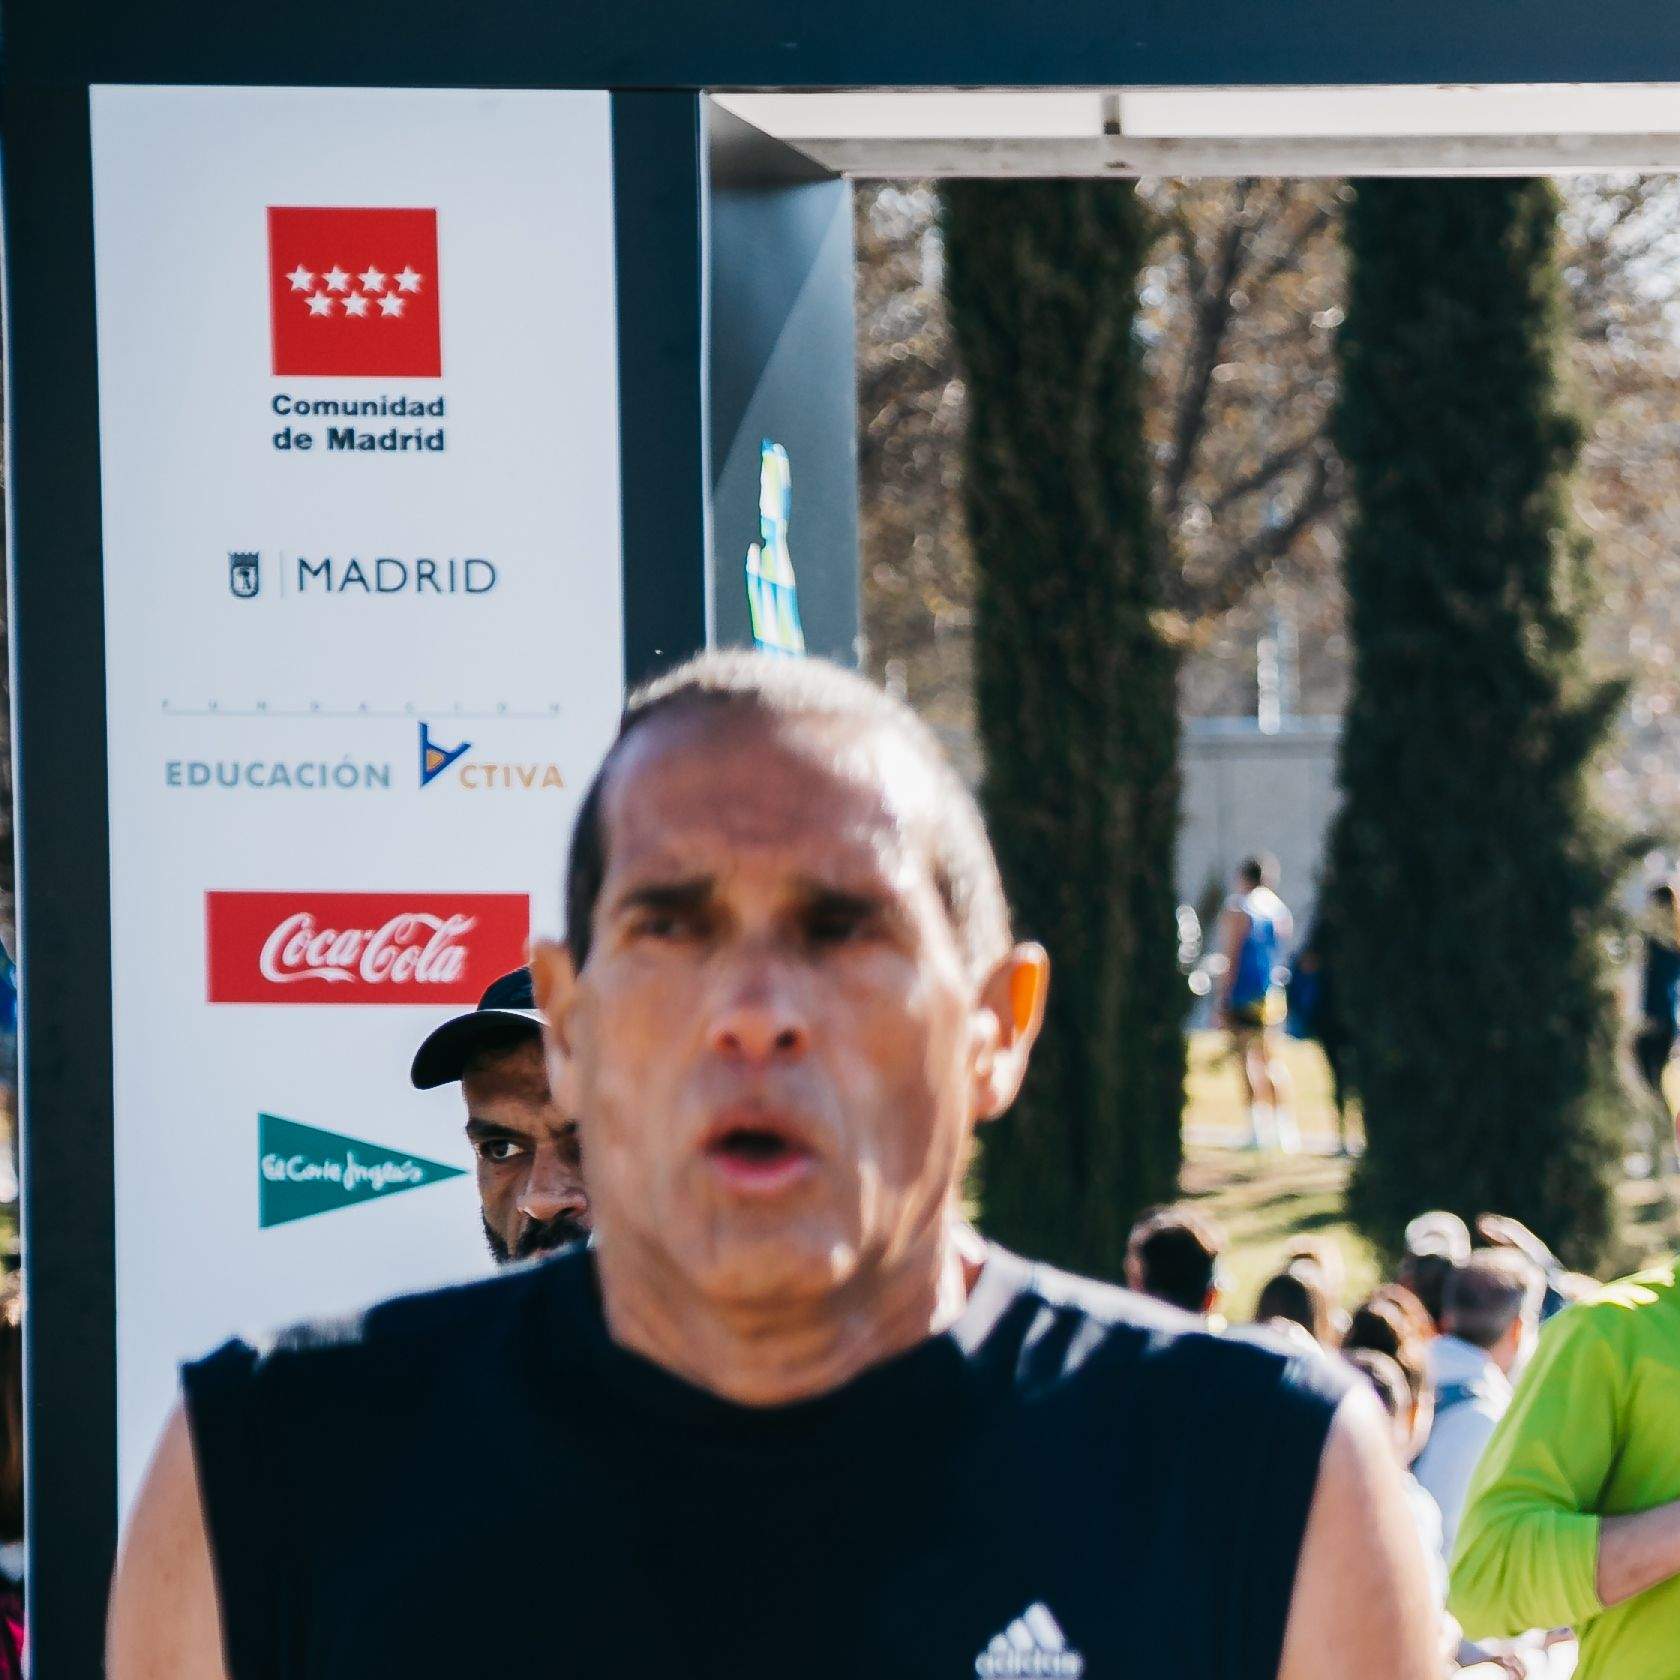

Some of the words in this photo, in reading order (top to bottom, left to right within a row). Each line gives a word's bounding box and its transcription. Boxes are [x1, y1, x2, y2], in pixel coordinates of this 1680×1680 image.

[271, 393, 446, 418] Comunidad
[272, 426, 313, 450] de
[326, 426, 446, 451] Madrid
[296, 556, 498, 594] MADRID
[164, 754, 392, 790] EDUCACIÓN
[259, 911, 479, 984] Coca-Cola
